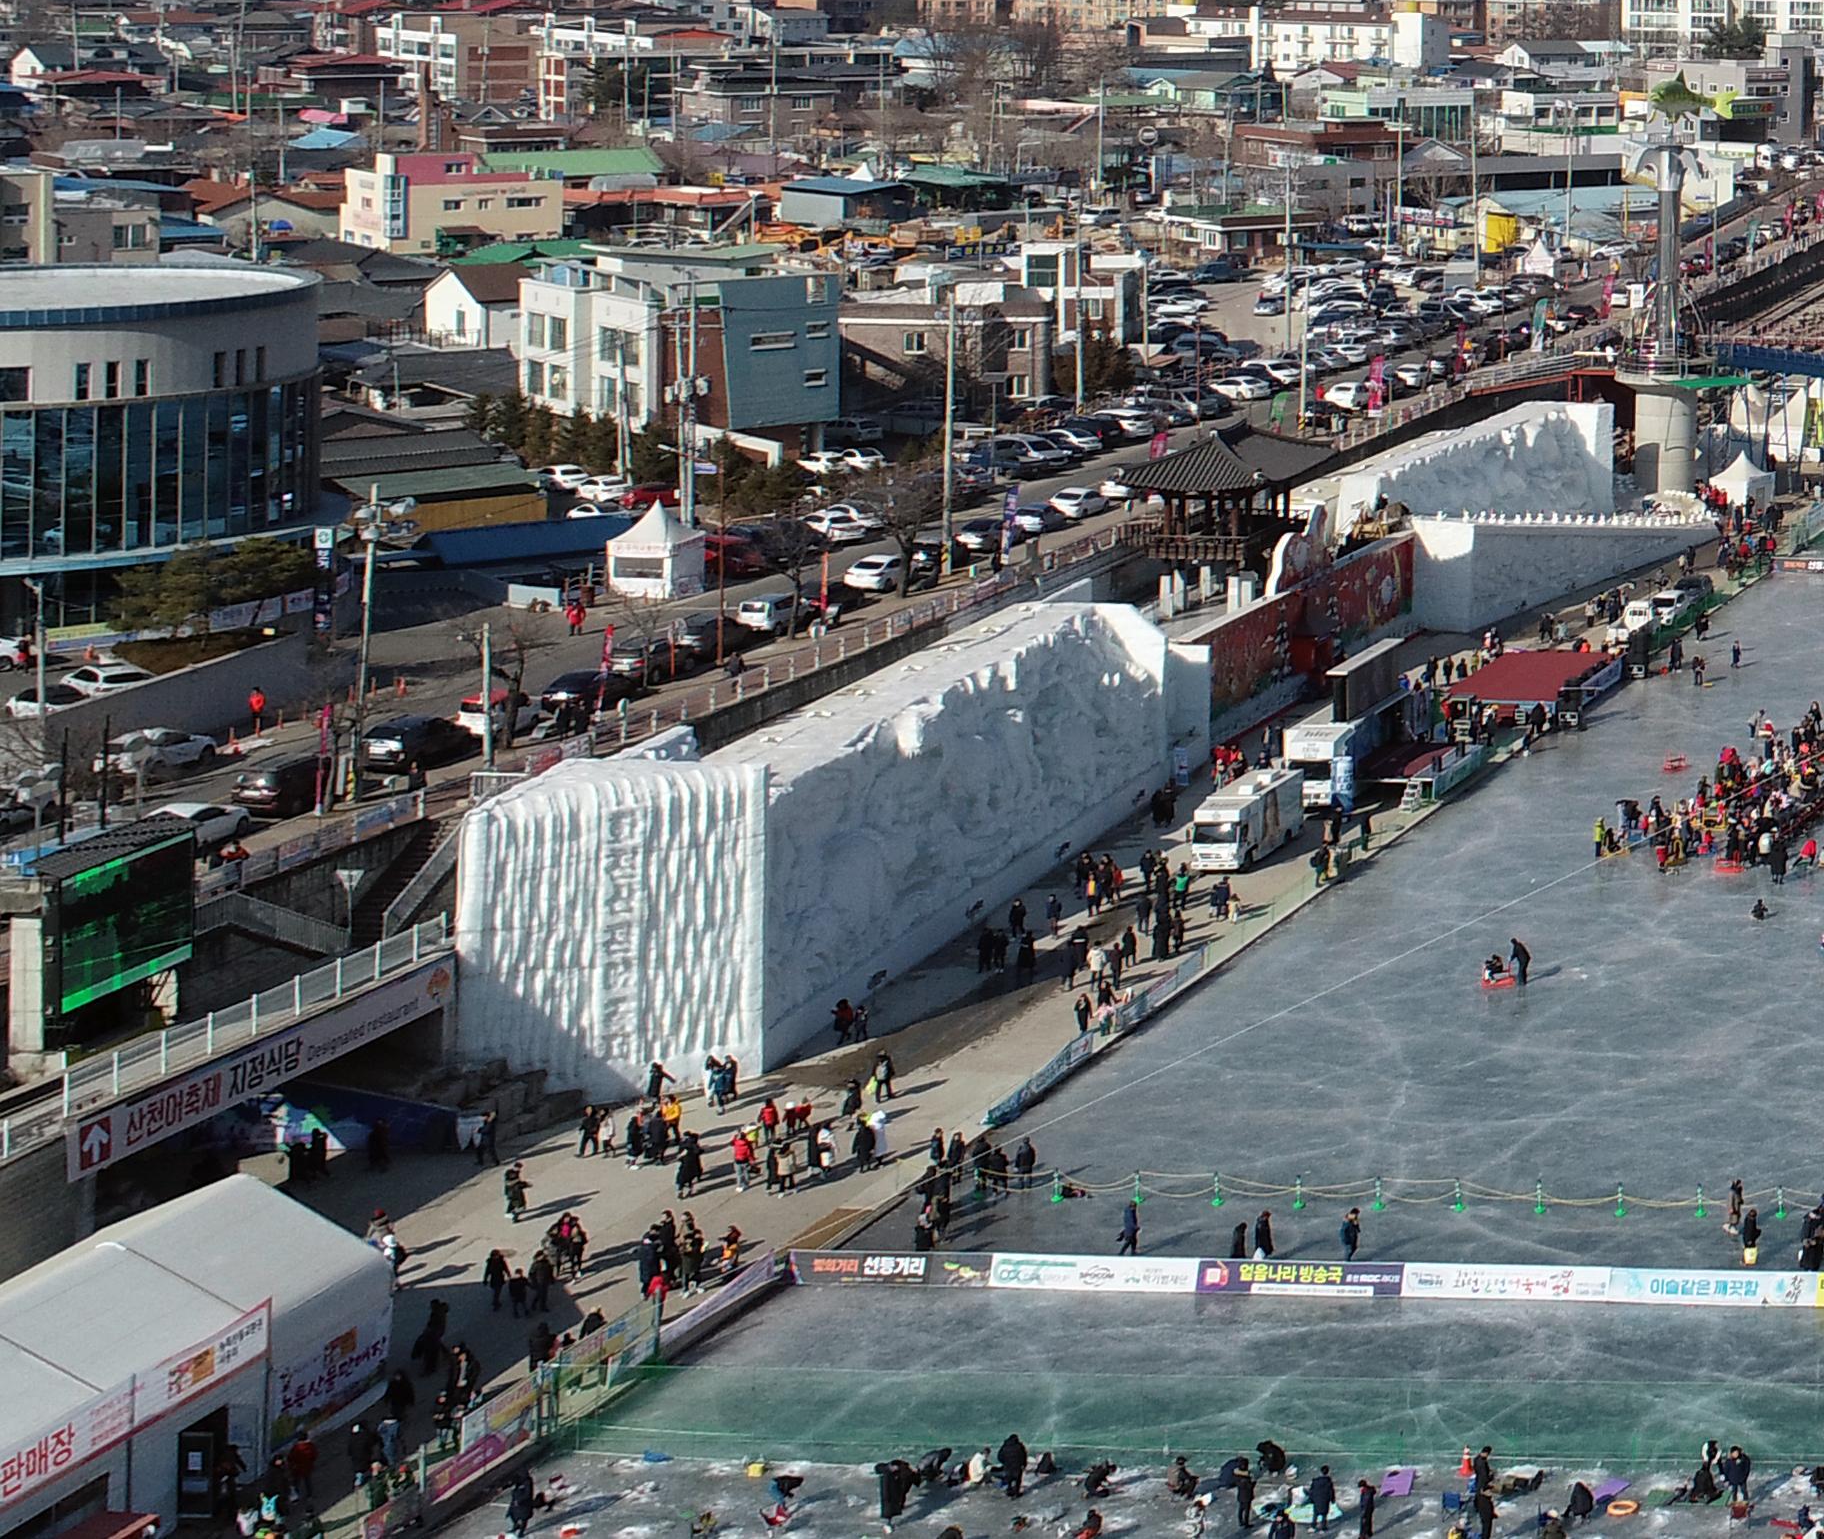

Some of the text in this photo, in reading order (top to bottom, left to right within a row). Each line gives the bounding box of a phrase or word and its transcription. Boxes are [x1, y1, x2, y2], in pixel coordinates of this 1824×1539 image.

[307, 999, 420, 1060] Designated restaurant
[125, 1035, 305, 1148] 산천어축제 지정식당
[864, 1256, 924, 1276] 선등거리
[1239, 1264, 1343, 1284] 얼음나라 방송국
[1650, 1279, 1711, 1295] 이슬같은
[0, 1423, 76, 1497] 판매장
